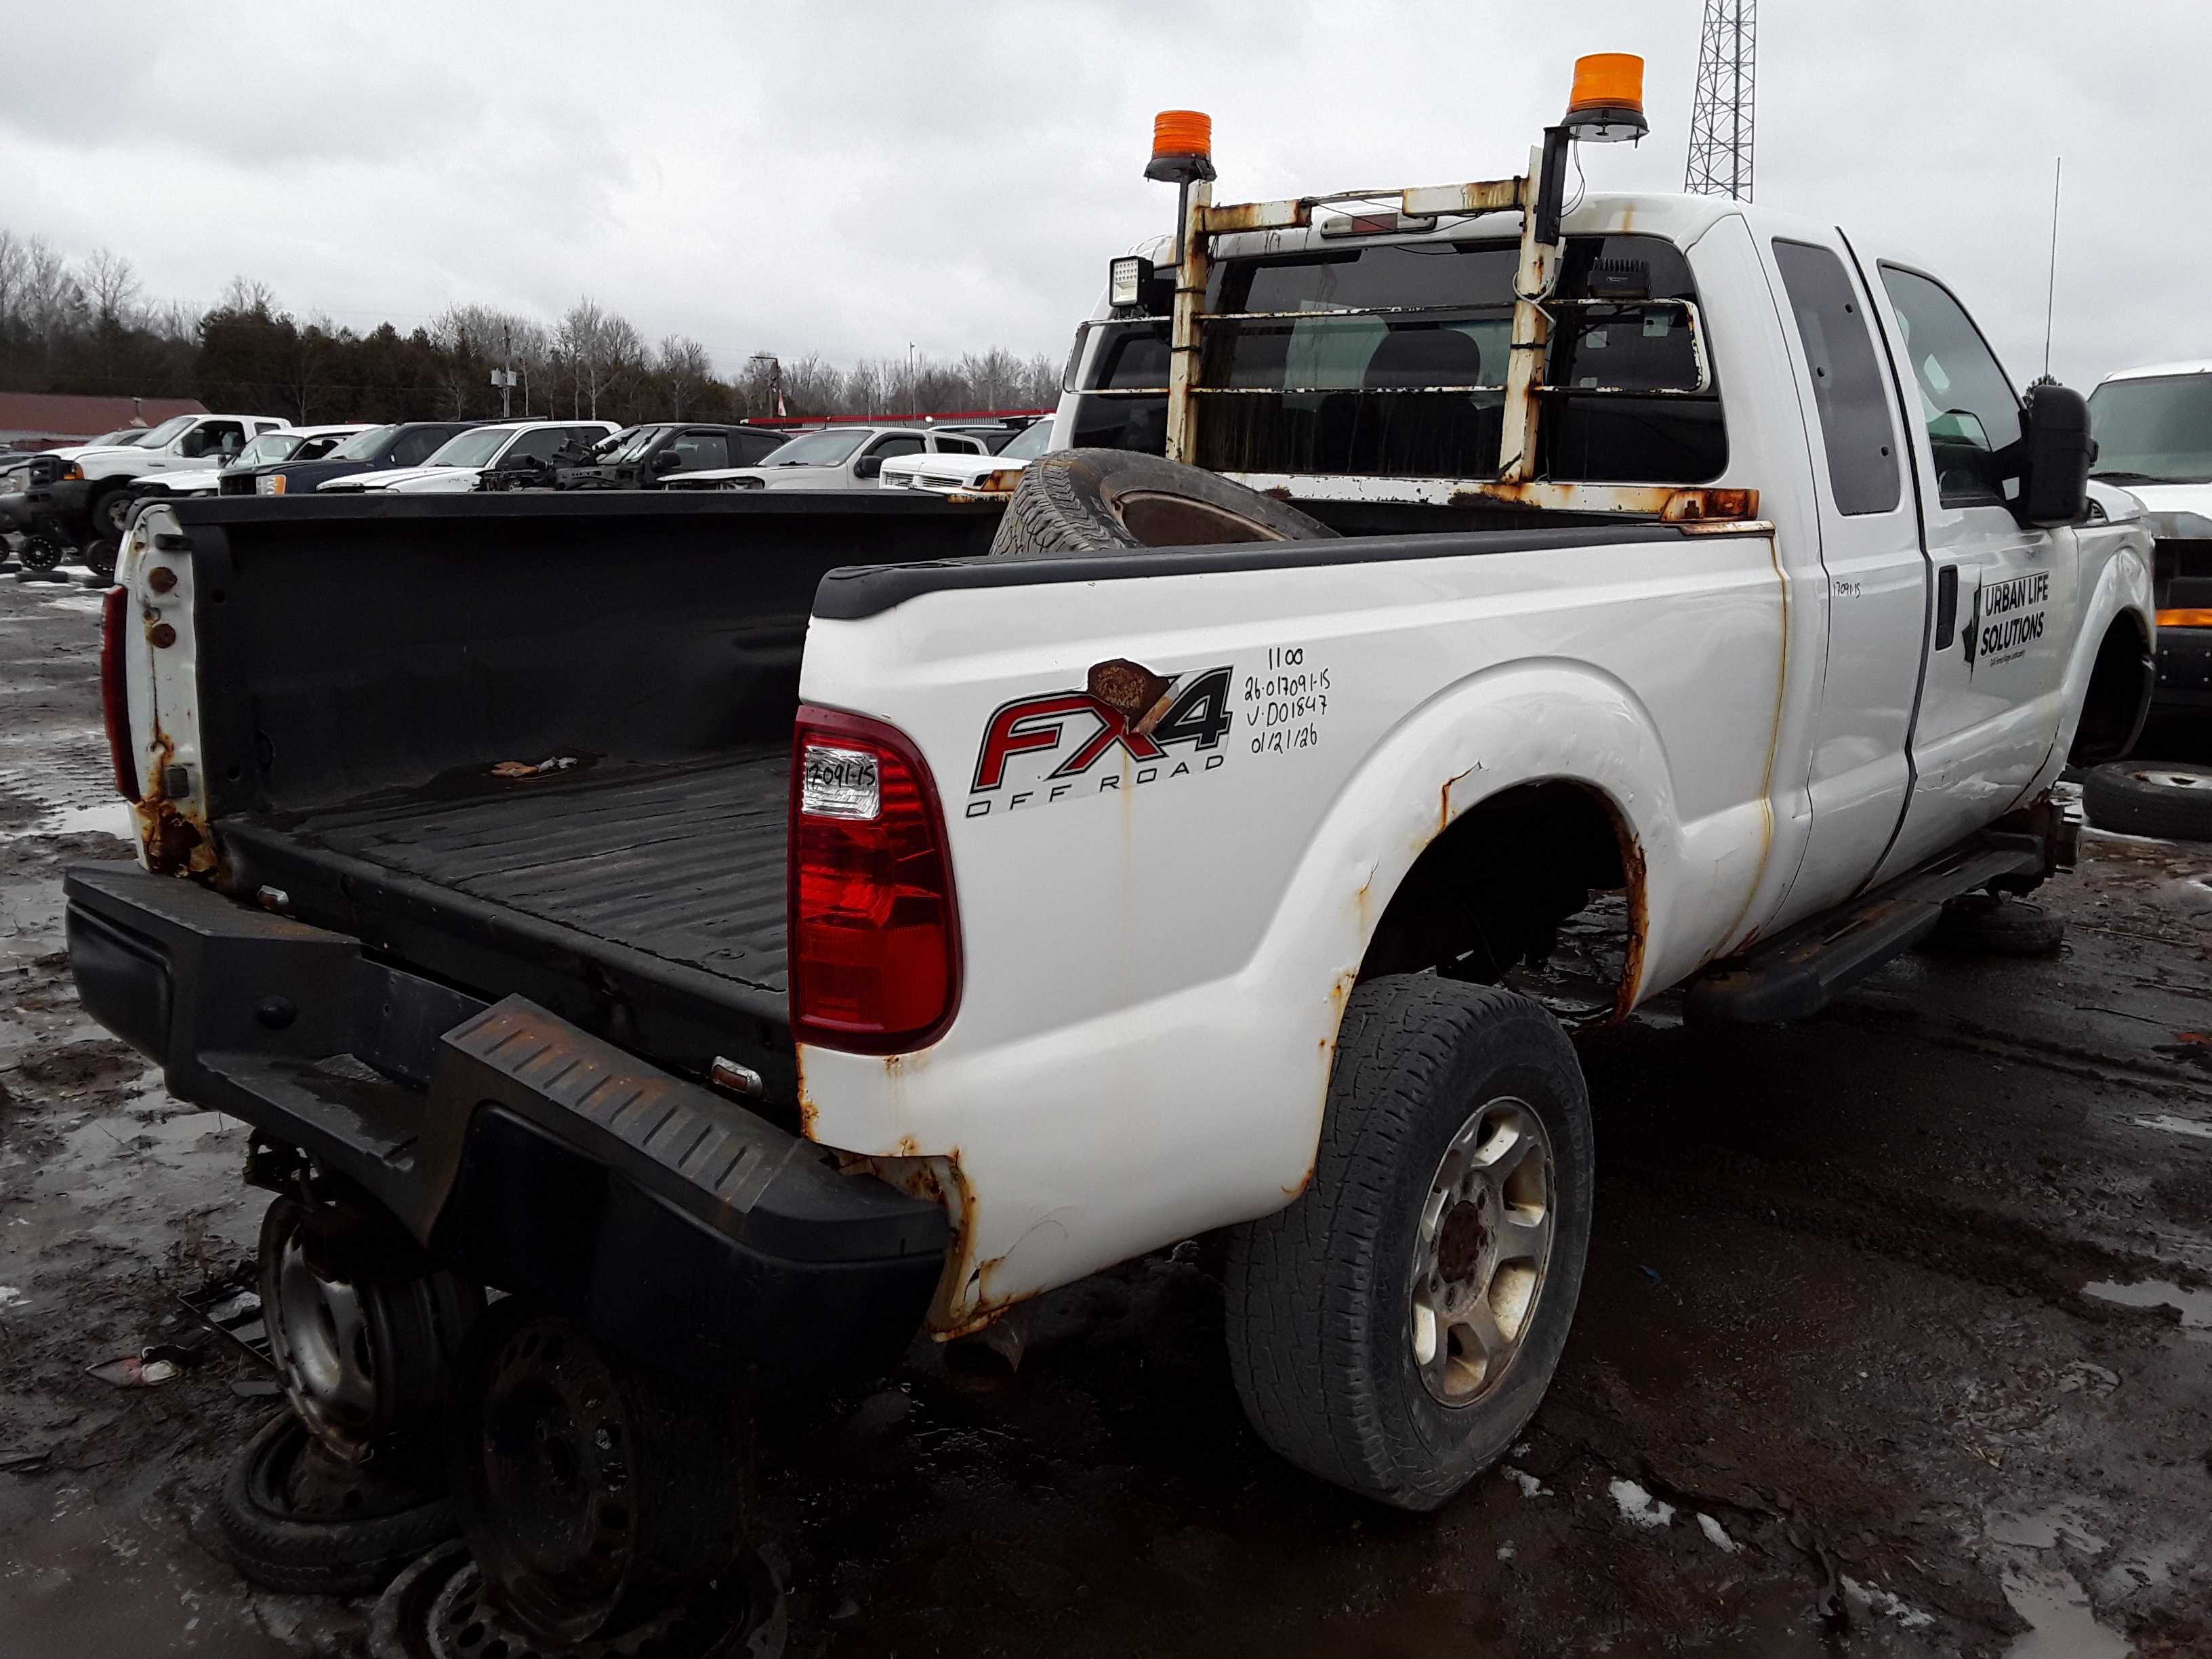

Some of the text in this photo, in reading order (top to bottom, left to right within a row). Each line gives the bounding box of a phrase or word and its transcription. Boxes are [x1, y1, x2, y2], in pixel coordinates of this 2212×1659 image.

[1985, 573, 2049, 617] URBAN LIFE
[1980, 611, 2045, 657] SOLUTIONS
[969, 665, 1234, 794] FX4
[965, 754, 1224, 819] OFF ROAD
